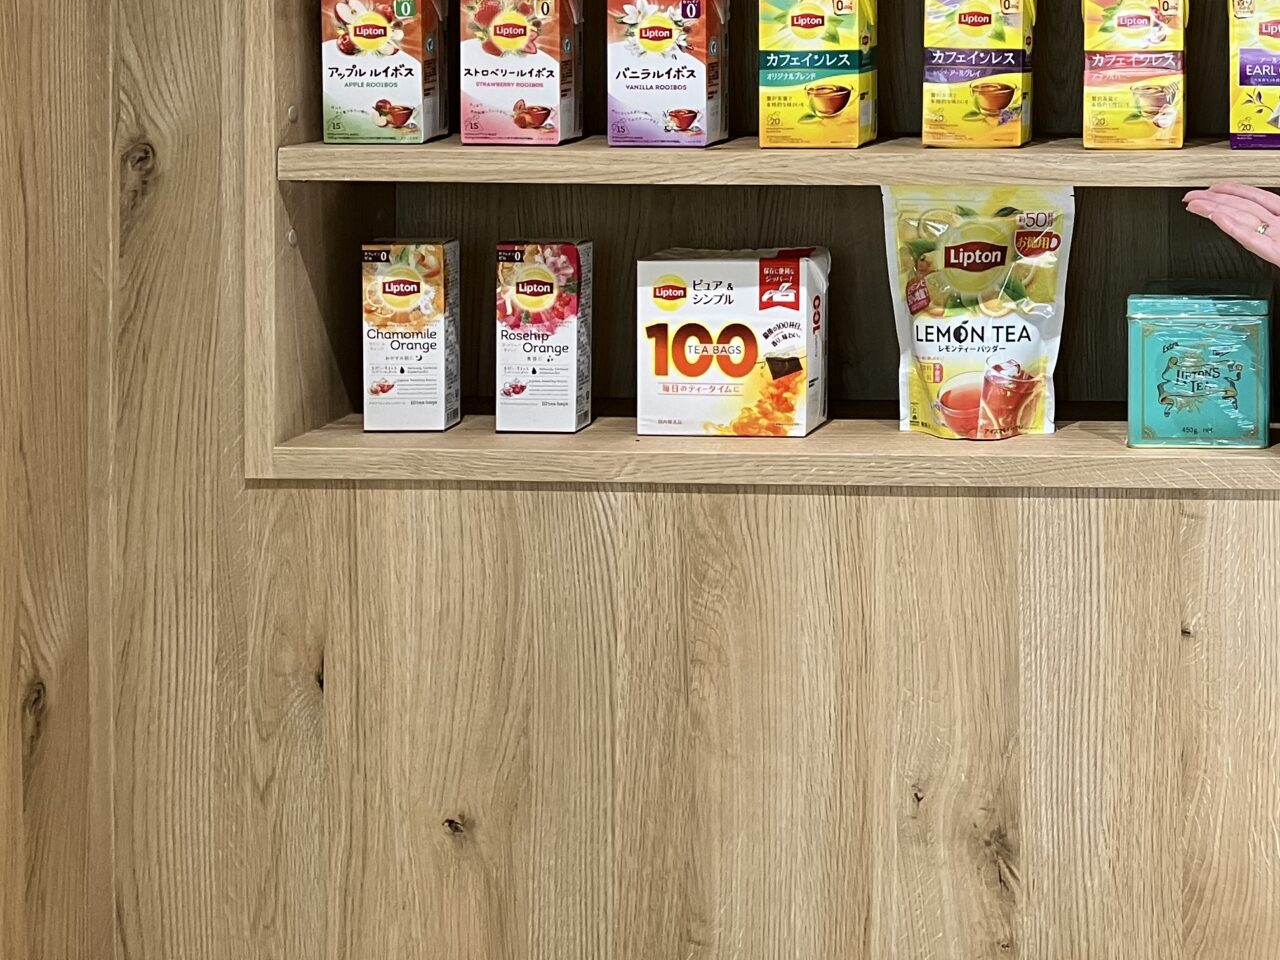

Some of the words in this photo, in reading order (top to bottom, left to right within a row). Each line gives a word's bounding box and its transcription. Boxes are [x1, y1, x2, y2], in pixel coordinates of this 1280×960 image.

[793, 16, 822, 27] Lipton
[961, 14, 989, 24] Lipton
[1120, 17, 1148, 26] Lipton
[356, 27, 385, 37] Lipton
[496, 26, 524, 36] Lipton
[642, 29, 670, 39] Lipton
[766, 53, 851, 67] カフェインレス
[931, 50, 1015, 64] カフェインレス
[328, 64, 366, 79] アップル
[370, 64, 414, 78] ルイボス
[464, 67, 555, 79] ストロベリールイボス
[616, 65, 697, 80] バニラルイボス
[766, 72, 816, 80] オリジナルブレンド
[1246, 65, 1277, 76] EARL
[950, 248, 1002, 266] Lipton
[385, 283, 418, 292] Lipton
[519, 283, 550, 293] Lipton
[693, 280, 723, 291] ピュア
[656, 289, 684, 298] Lipton
[693, 293, 734, 305] シンプル
[367, 328, 437, 339] Chamomile
[501, 330, 550, 344] Rosehip
[915, 321, 985, 344] LEMON
[992, 325, 1031, 343] TEA
[390, 340, 437, 353] Orange
[523, 342, 569, 356] Orange
[645, 323, 758, 378] 100
[688, 345, 709, 354] TEA
[713, 345, 742, 354] BAGS
[938, 344, 1006, 353] レモンティーパウダー
[662, 384, 740, 393] 毎日のティータイムに
